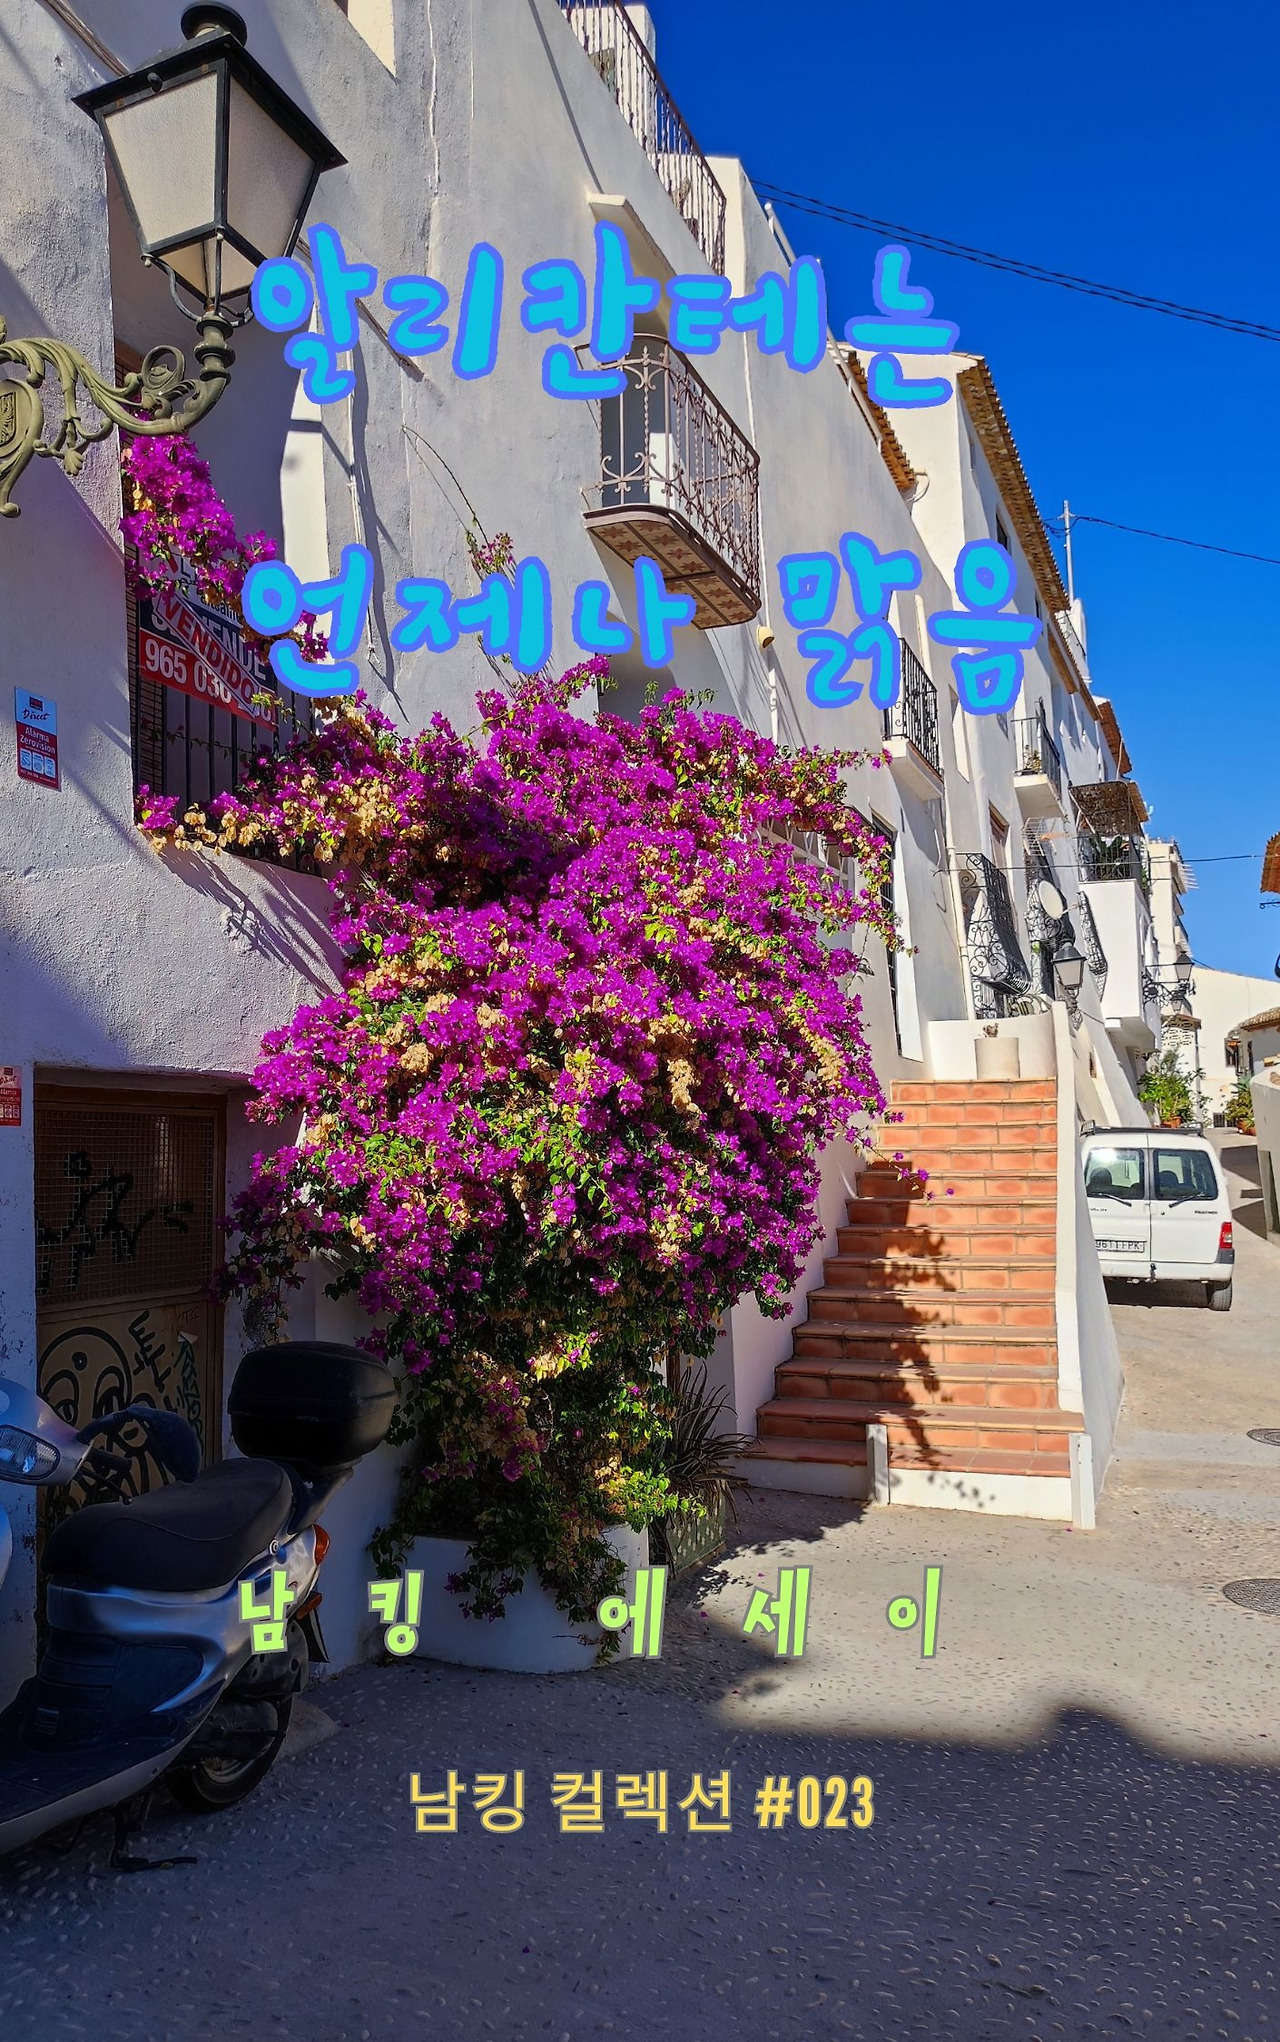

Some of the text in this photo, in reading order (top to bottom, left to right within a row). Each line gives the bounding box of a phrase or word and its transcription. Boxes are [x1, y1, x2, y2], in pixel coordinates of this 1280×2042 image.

[145, 638, 187, 684] 965
[161, 596, 255, 700] VENDIDO
[20, 734, 56, 754] Zerovision
[25, 727, 49, 742] Alarma
